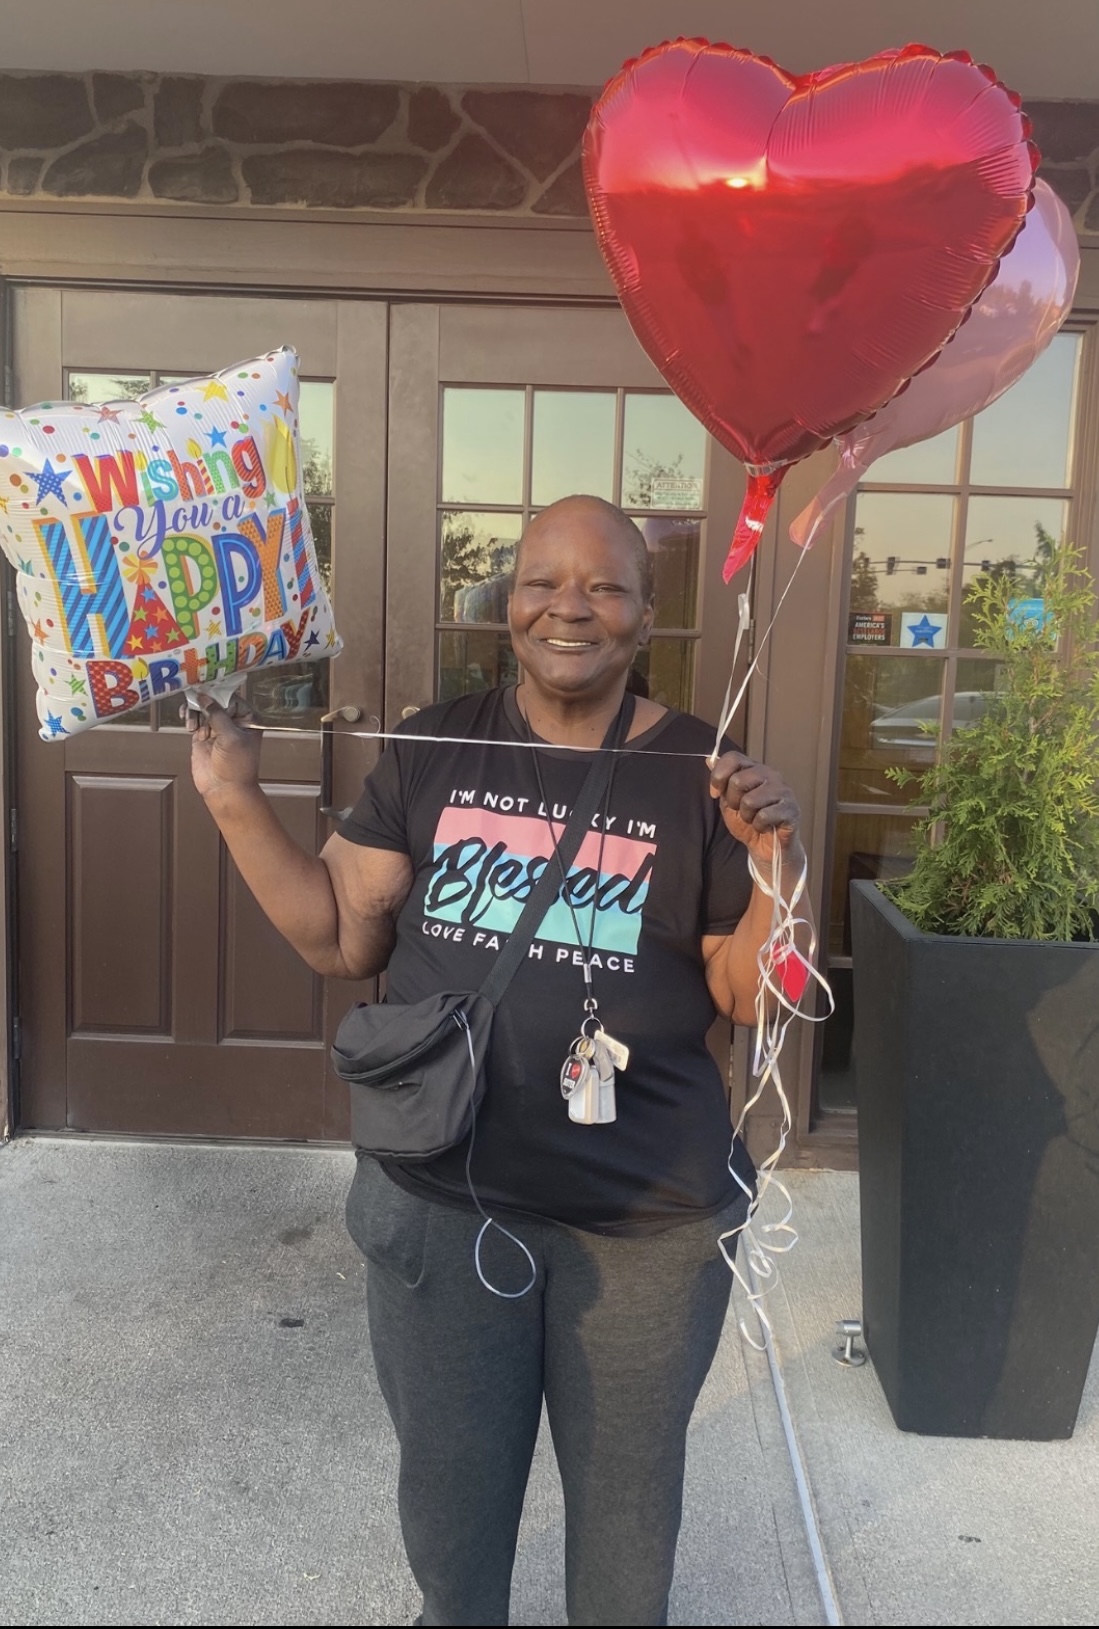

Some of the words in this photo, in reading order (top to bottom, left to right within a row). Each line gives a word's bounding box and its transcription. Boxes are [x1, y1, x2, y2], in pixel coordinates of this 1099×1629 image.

[71, 435, 267, 514] Wishing
[113, 498, 213, 561] You
[222, 493, 246, 522] a
[852, 633, 886, 641] EMPLOYERS
[449, 789, 476, 805] I'M
[483, 791, 529, 813] NOT
[537, 802, 617, 830] LUKY
[626, 819, 657, 839] I'M
[425, 836, 656, 925] Blesed
[421, 921, 466, 943] LOVE
[472, 932, 544, 960] FAH
[556, 947, 635, 973] PEACE
